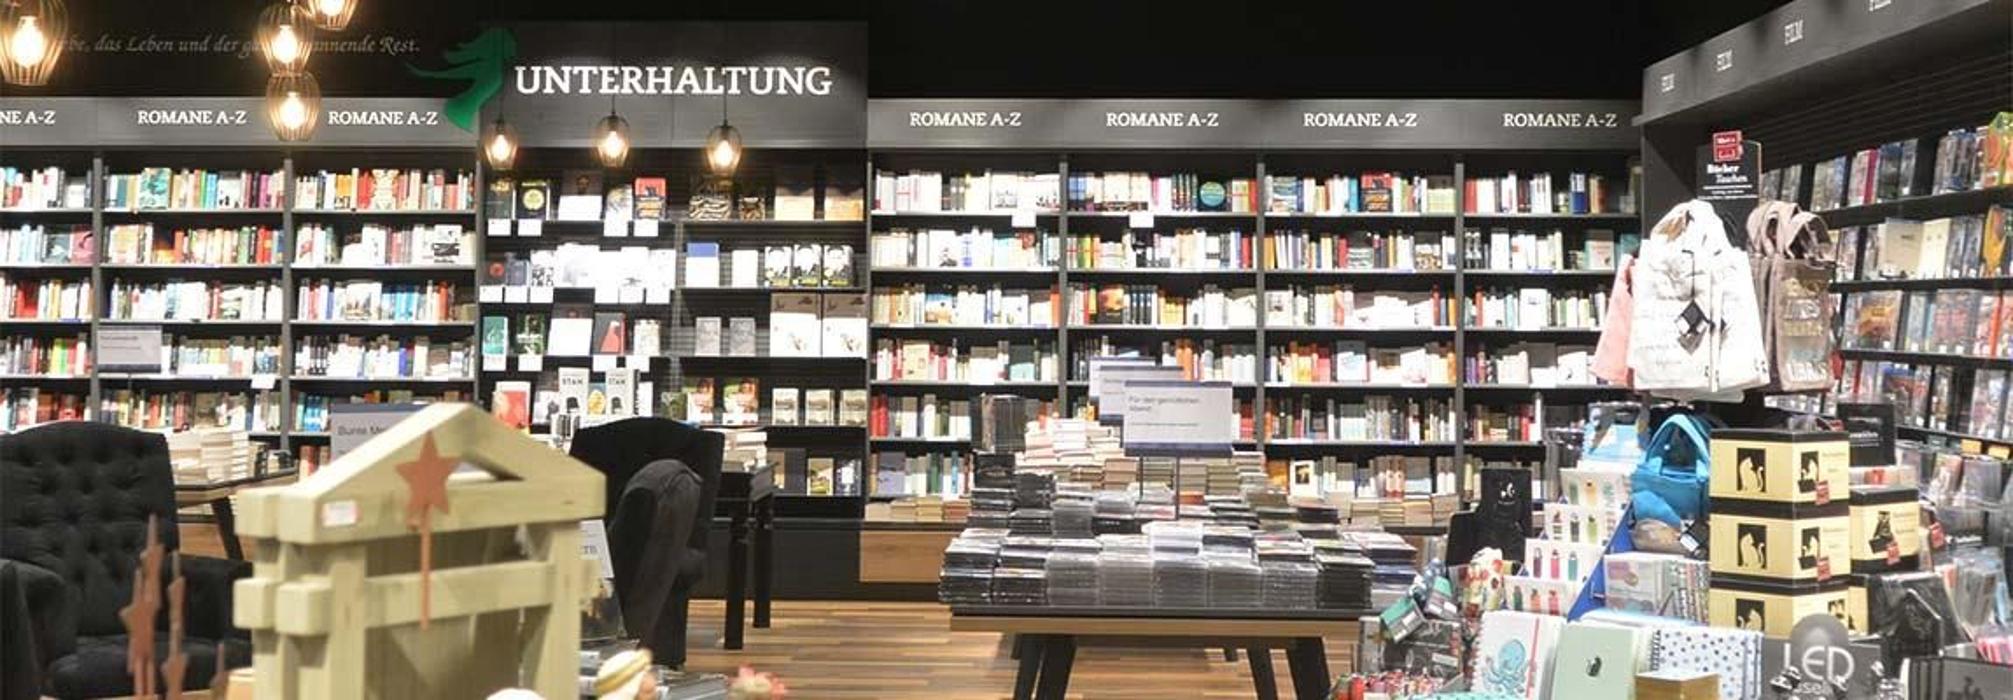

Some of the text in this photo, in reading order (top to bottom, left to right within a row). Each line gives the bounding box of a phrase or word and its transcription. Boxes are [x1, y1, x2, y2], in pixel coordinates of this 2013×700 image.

[93, 33, 123, 54] das
[125, 34, 174, 54] Leben
[177, 34, 213, 54] und
[213, 34, 240, 54] der
[379, 34, 421, 56] Rest.
[515, 65, 834, 95] UNTERHALTUNG
[24, 110, 57, 125] A-Z
[137, 110, 248, 126] ROMANE A-Z
[328, 110, 439, 126] ROMANE A-Z
[909, 111, 1022, 127] ROMANE A-Z
[1105, 112, 1220, 127] ROMANE A-Z
[1303, 112, 1418, 127] ROMANE A-Z
[1503, 112, 1618, 128] ROMANE A-Z
